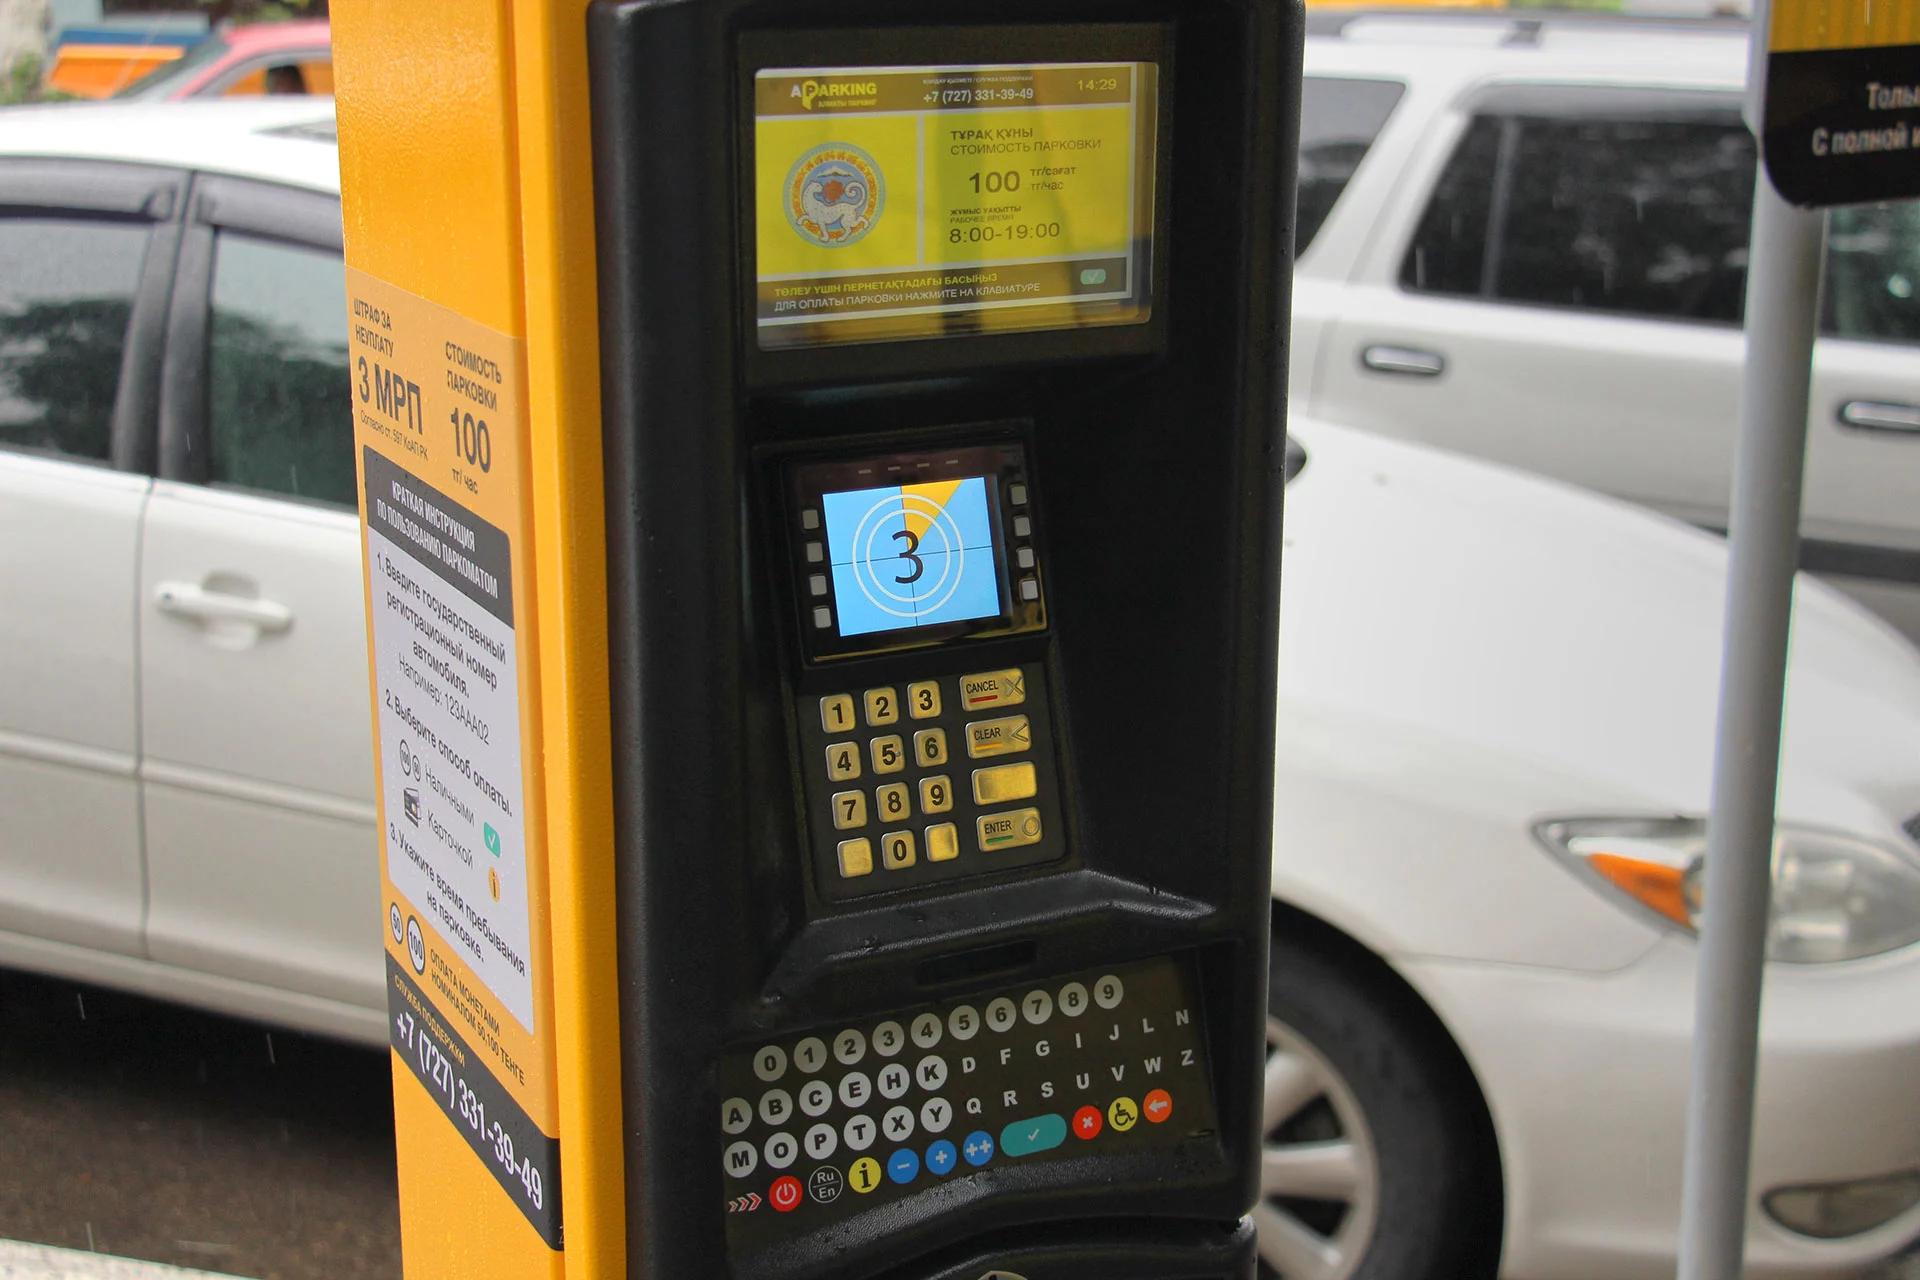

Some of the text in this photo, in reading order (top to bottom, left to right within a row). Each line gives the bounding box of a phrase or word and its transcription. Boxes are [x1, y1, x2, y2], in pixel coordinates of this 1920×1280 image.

[923, 88, 1034, 104] +7 (727) 331-39-49
[1077, 78, 1117, 90] 14:29
[951, 139, 1102, 156] СТОИМОСТЬ ПАРКОВКИ
[969, 170, 1020, 194] 100
[950, 222, 1060, 244] 8:00-19:00
[354, 298, 392, 331] ШТРАФ ЗА
[774, 283, 1040, 312] ДЛЯ ОПЛАТЫ ПАРКОВКИ НАЖМИТЕ НА КЛАВИАТУРЕ
[356, 324, 394, 358] НЕУПЛАТУ
[446, 341, 502, 385] СТОИМОСТЬ
[358, 356, 423, 436] 3 МРП
[447, 370, 497, 412] ПАРКОВКИ
[450, 407, 491, 474] 100
[392, 480, 476, 552] КРАТКАЯ ИНСТРУКЦИЯ
[377, 498, 499, 600] ПО ПОЛЬЗОВАНИЮ ПАРКОМАТОМ
[892, 530, 924, 584] 3
[386, 590, 498, 692] регистрационный номер
[422, 588, 506, 664] государственный
[399, 652, 442, 706] Например:
[413, 640, 470, 698] автомобиля.
[966, 679, 998, 694] CANCEL
[832, 690, 932, 724] 1 2 3
[838, 738, 939, 771] 4 5 6
[974, 728, 1001, 740] CLEAR
[425, 764, 474, 827] Наличными
[438, 738, 471, 780] способ
[474, 772, 513, 817] оплаты.
[842, 784, 944, 820] 7 8 9
[428, 809, 474, 870] Карточкой
[892, 840, 906, 861] 0
[984, 820, 1012, 834] ENTER
[410, 932, 422, 960] 100
[426, 891, 484, 963] на парковке.
[436, 872, 464, 913] время
[466, 902, 526, 978] пребывания
[430, 948, 500, 1037] ОПЛАТА МОНЕТАМИ
[432, 968, 476, 1028] НОМИНАЛОМ
[500, 1046, 525, 1086] ТЕНГЕ
[764, 984, 1114, 1072] 0 1 2 3 4 5 6 7 8 9
[728, 1010, 1190, 1126] A B C E H K D F G I J L N
[397, 1011, 542, 1211] +7 (727) 331-39-49
[732, 1050, 1194, 1169] M O P T X Y Q R S U V W Z
[817, 1172, 834, 1184] Ru
[819, 1187, 836, 1199] En
